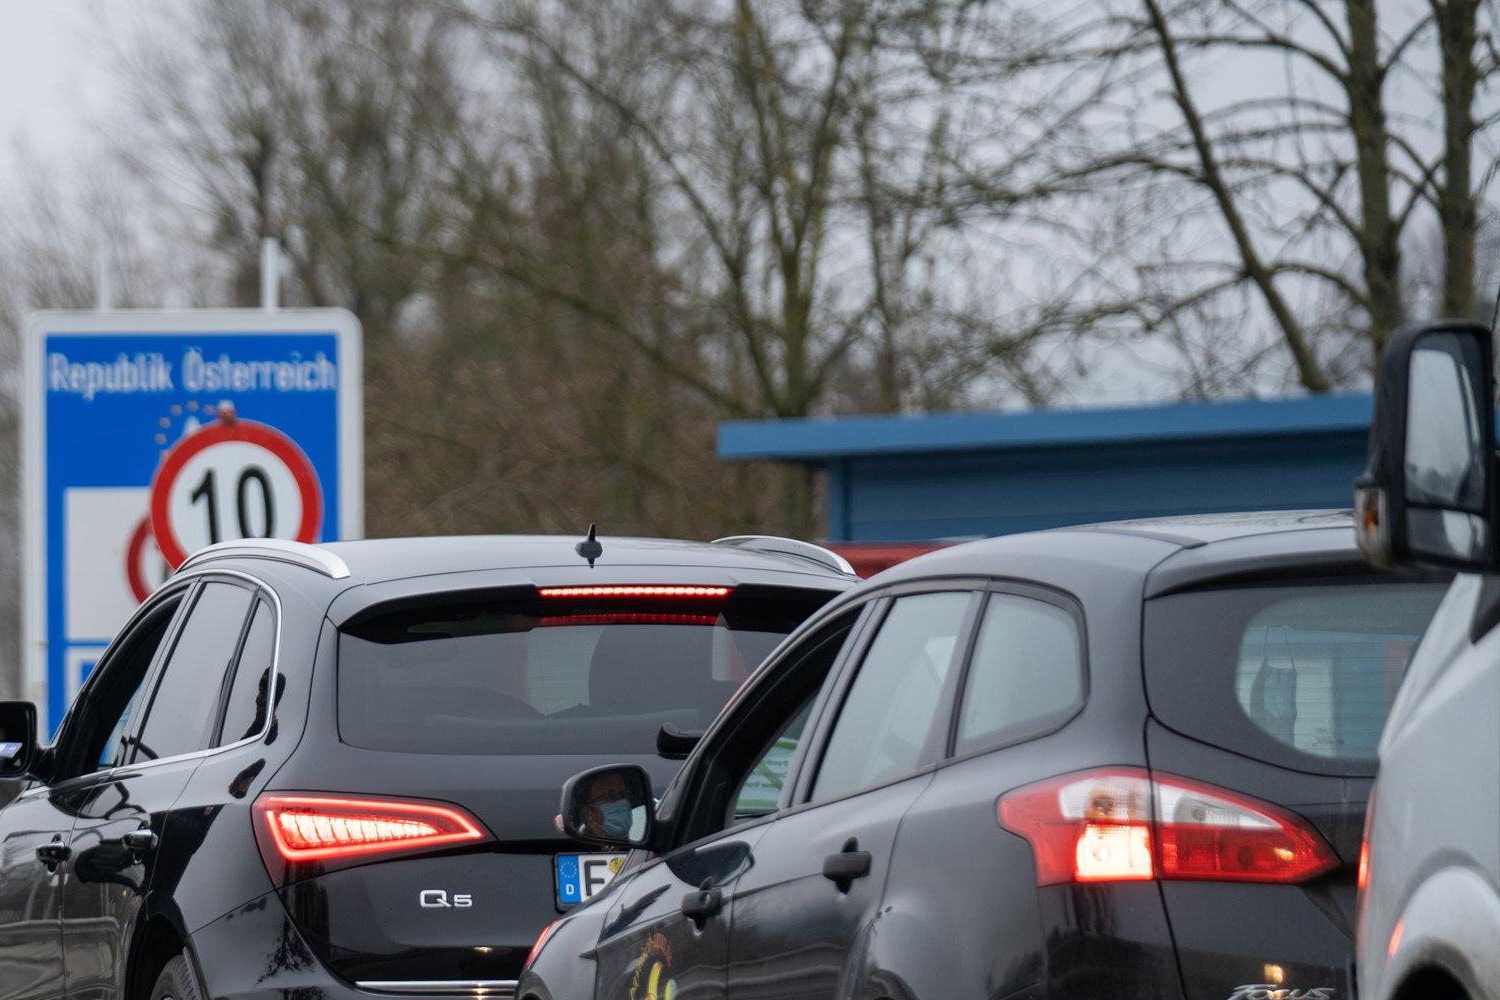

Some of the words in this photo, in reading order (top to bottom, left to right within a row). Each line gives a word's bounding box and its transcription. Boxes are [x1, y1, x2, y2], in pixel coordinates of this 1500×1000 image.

[49, 352, 173, 400] Republik
[183, 346, 336, 393] Österreich
[190, 466, 276, 544] 10
[419, 889, 473, 908] Q5
[565, 883, 575, 896] D
